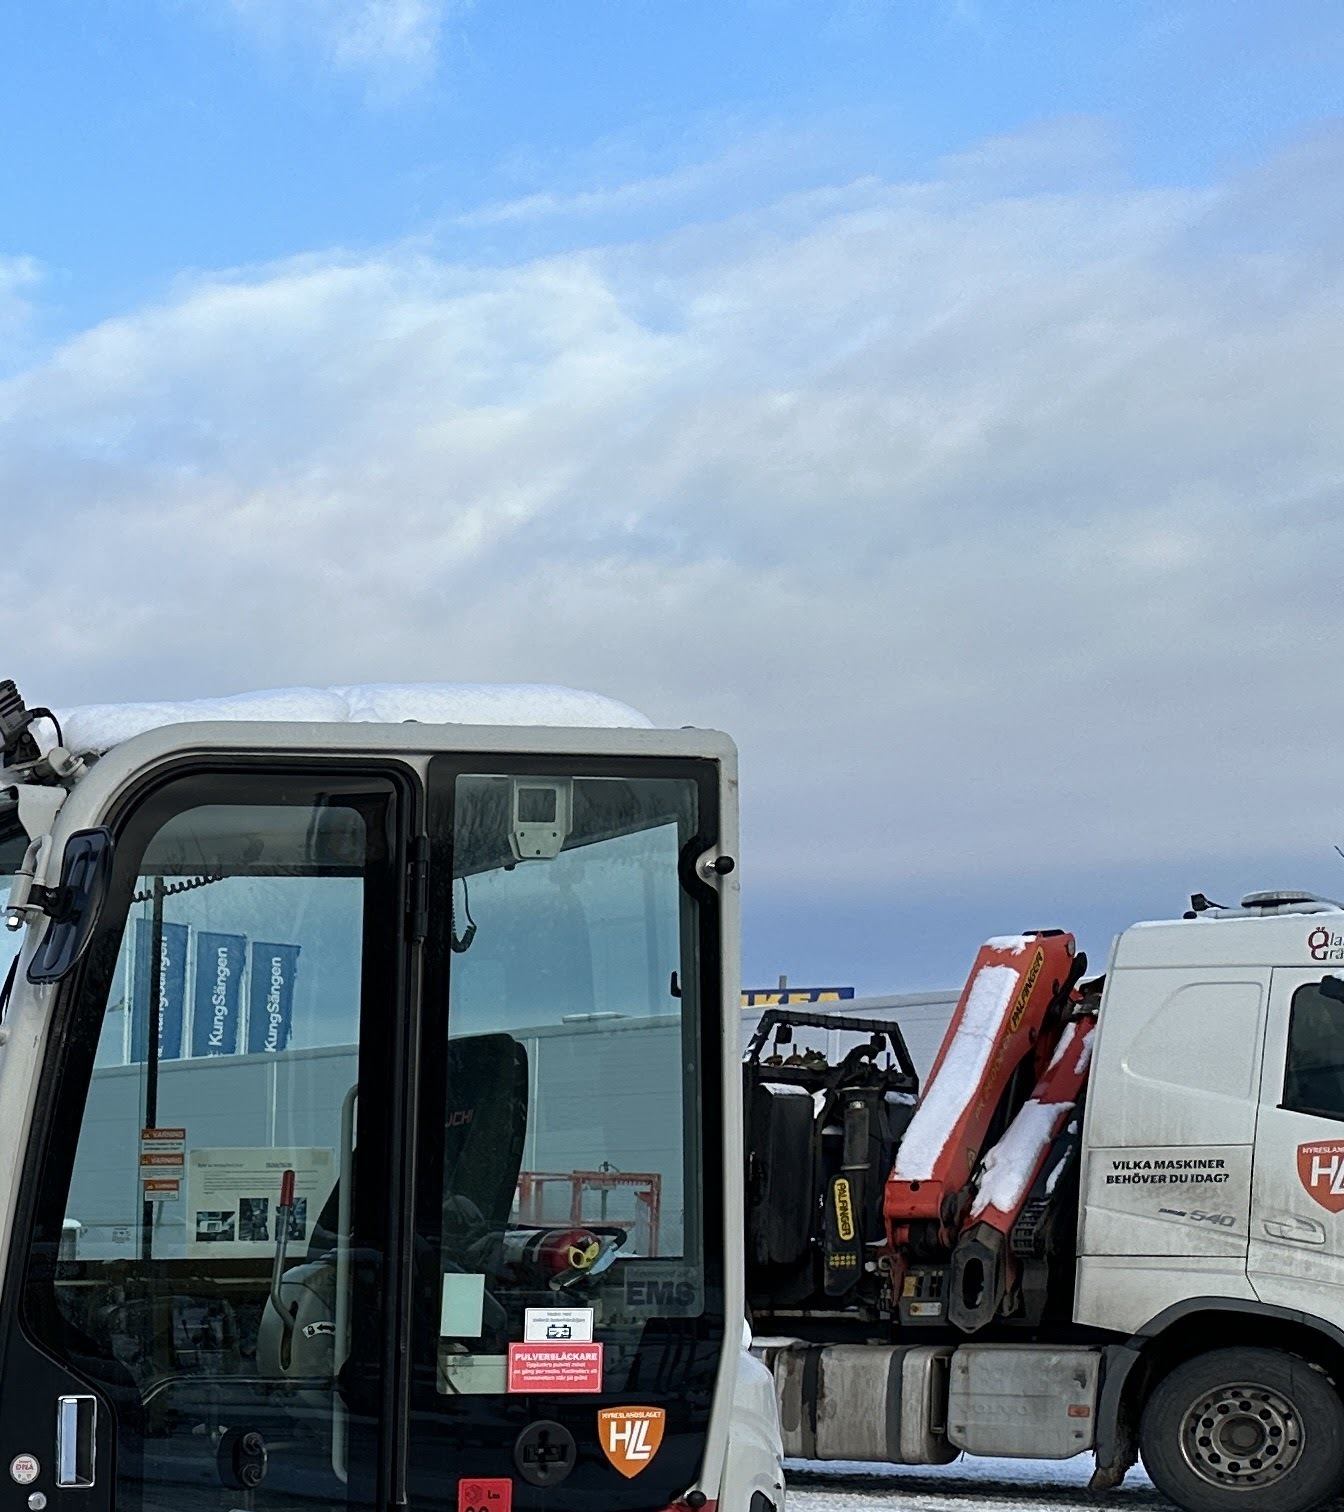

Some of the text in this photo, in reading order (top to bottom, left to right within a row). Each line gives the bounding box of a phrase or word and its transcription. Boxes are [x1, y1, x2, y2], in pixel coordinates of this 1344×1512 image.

[1112, 1159, 1225, 1170] VILKA MASKINER
[1311, 1156, 1344, 1195] HL
[1106, 1172, 1230, 1184] BEHÖVER DU IDAG?
[837, 1182, 851, 1237] PALFINGER
[1189, 1209, 1237, 1228] 540
[627, 1281, 696, 1306] EMS
[609, 1419, 652, 1460] HLL
